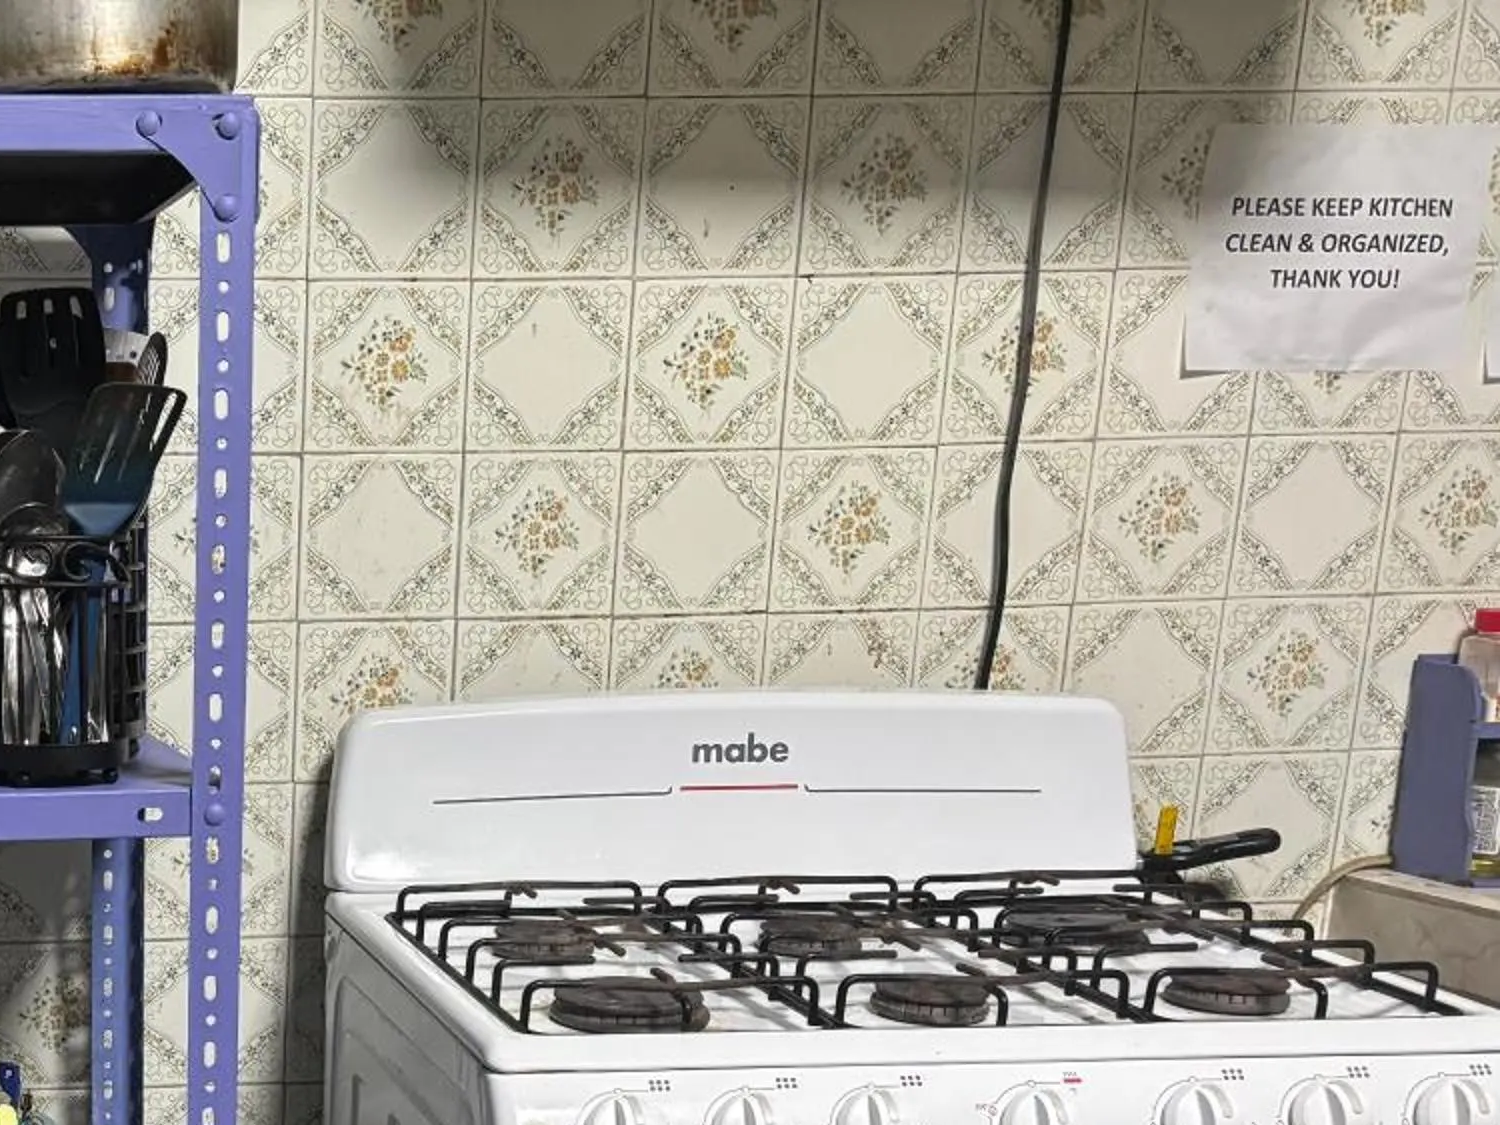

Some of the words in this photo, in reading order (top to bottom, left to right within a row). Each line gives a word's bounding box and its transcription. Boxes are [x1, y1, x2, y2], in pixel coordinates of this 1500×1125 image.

[1231, 197, 1306, 217] PLEASE
[1311, 197, 1364, 217] KEEP
[1369, 197, 1453, 218] KITCHEN
[1225, 233, 1293, 253] CLEAN
[1297, 233, 1315, 253] &
[1321, 233, 1449, 257] ORGANIZED,
[1270, 269, 1342, 289] THANK
[1348, 269, 1400, 289] YOU!
[692, 732, 789, 763] mabe
